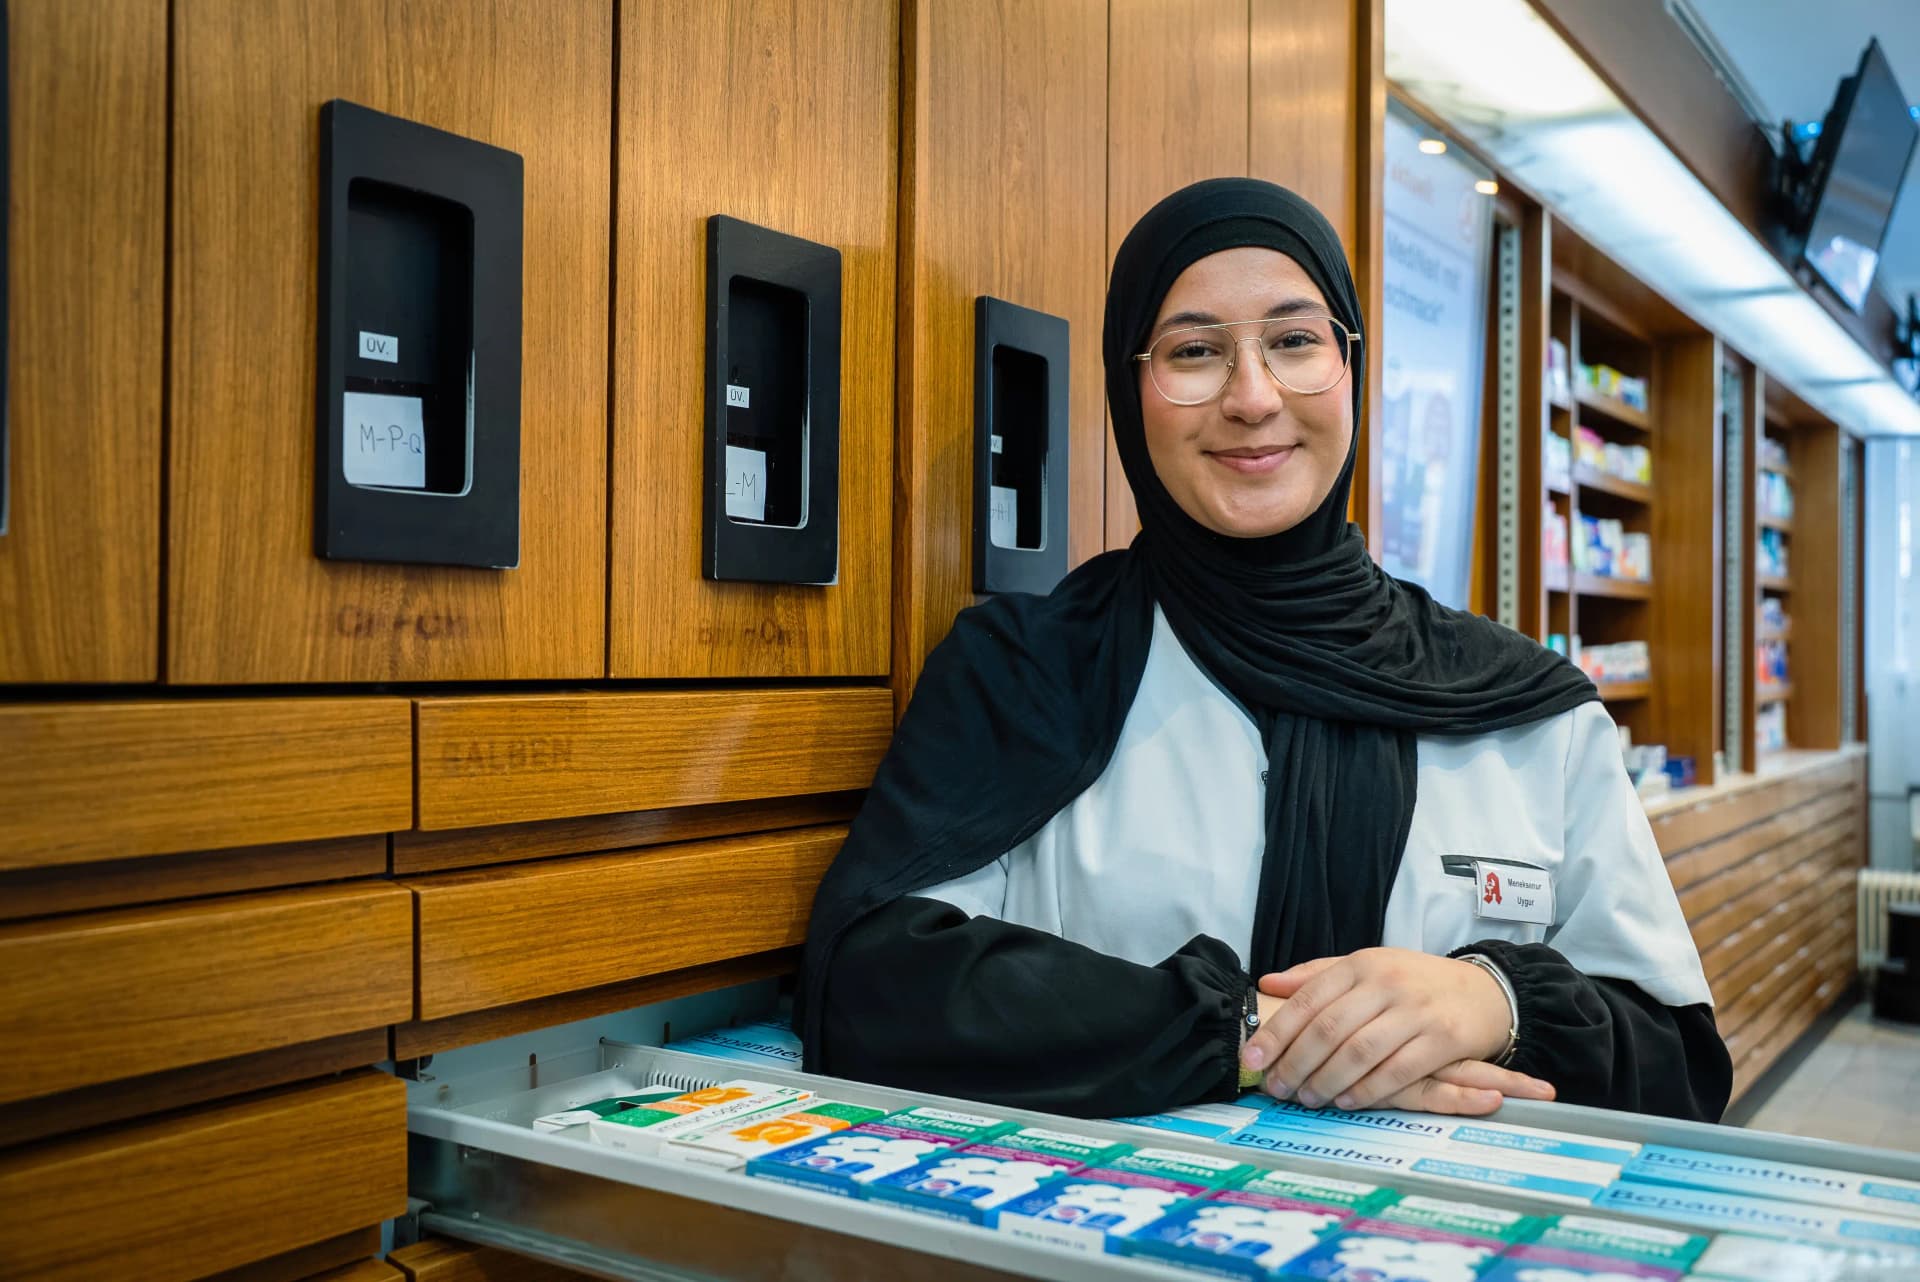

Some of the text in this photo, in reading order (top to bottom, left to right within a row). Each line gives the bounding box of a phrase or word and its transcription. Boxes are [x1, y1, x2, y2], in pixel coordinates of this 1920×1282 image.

[1517, 897, 1535, 908] Uygur
[1281, 1102, 1443, 1134] Bepanthen
[1236, 1133, 1403, 1166] Bepanthen
[1643, 1152, 1847, 1191] Bepanthen
[1608, 1188, 1824, 1229] Bepanthen
